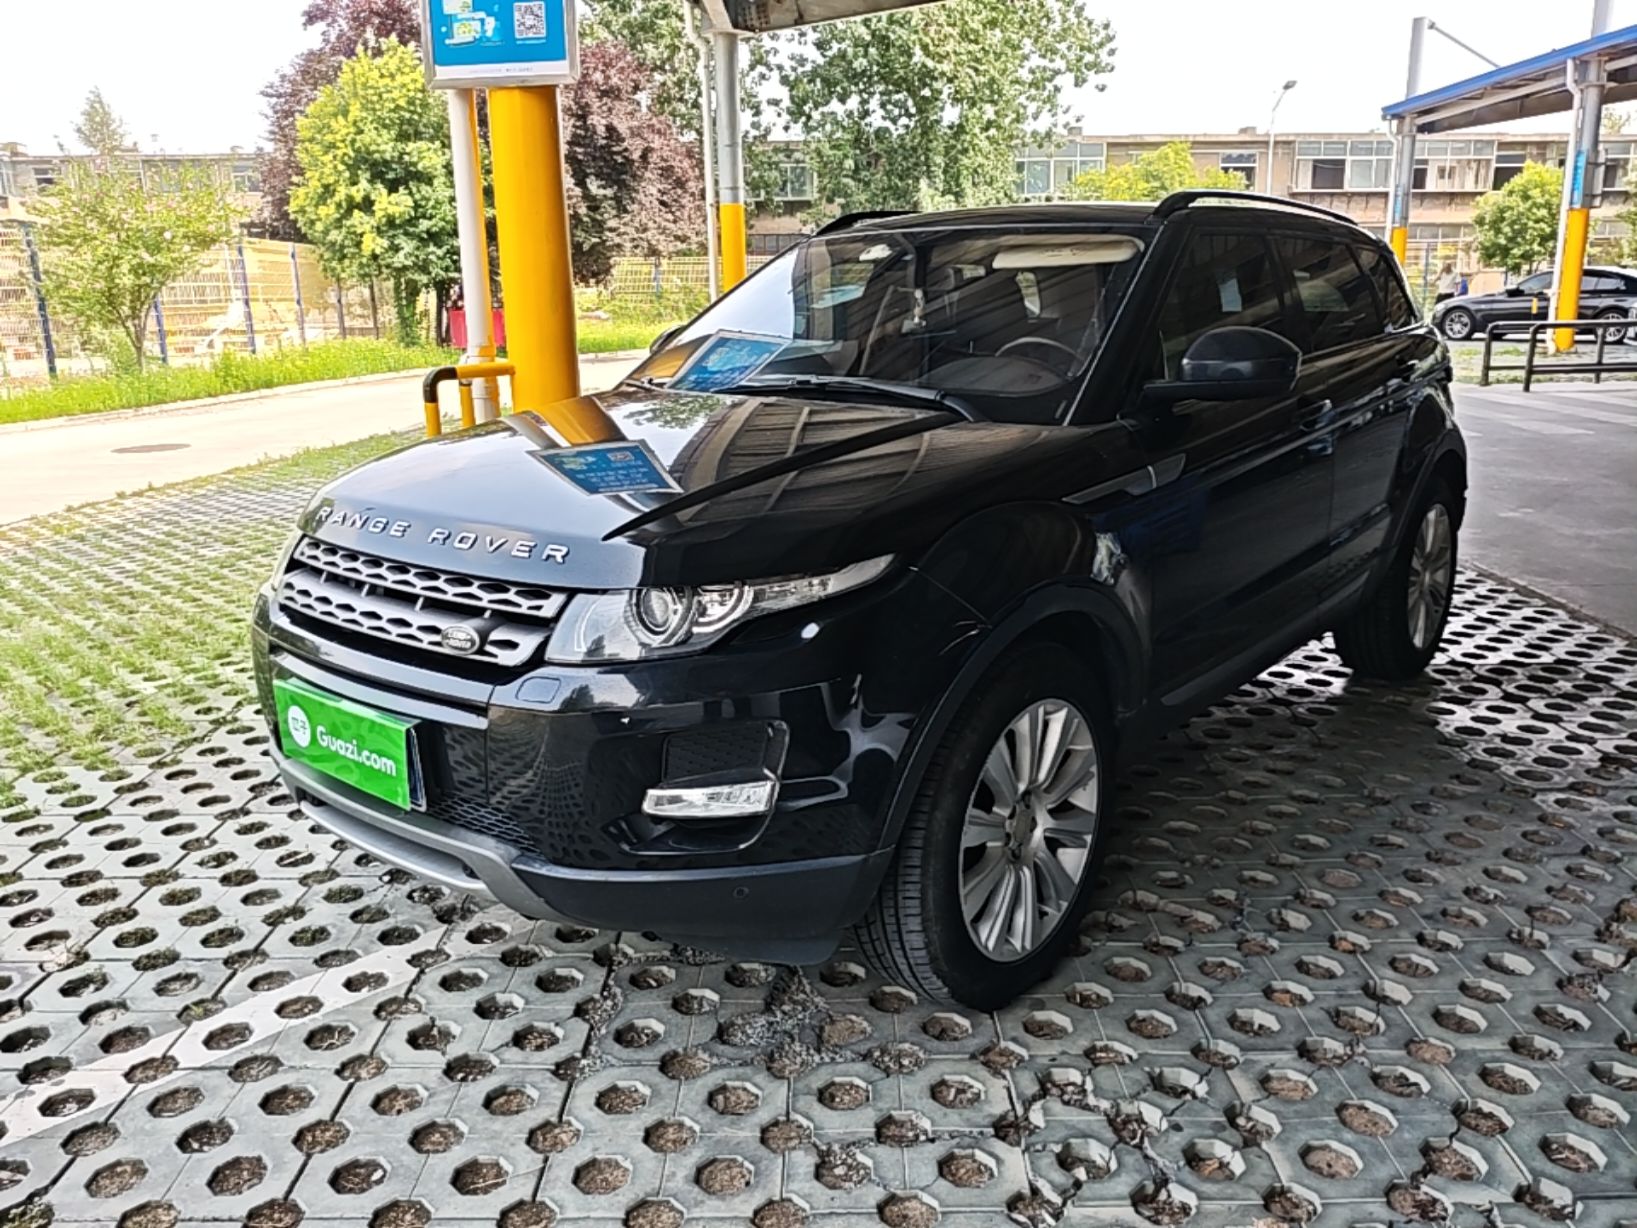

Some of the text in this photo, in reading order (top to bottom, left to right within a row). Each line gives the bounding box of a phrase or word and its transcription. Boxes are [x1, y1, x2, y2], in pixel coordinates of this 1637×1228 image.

[315, 506, 570, 564] RANGE ROVER
[316, 725, 397, 777] Guazi.com
